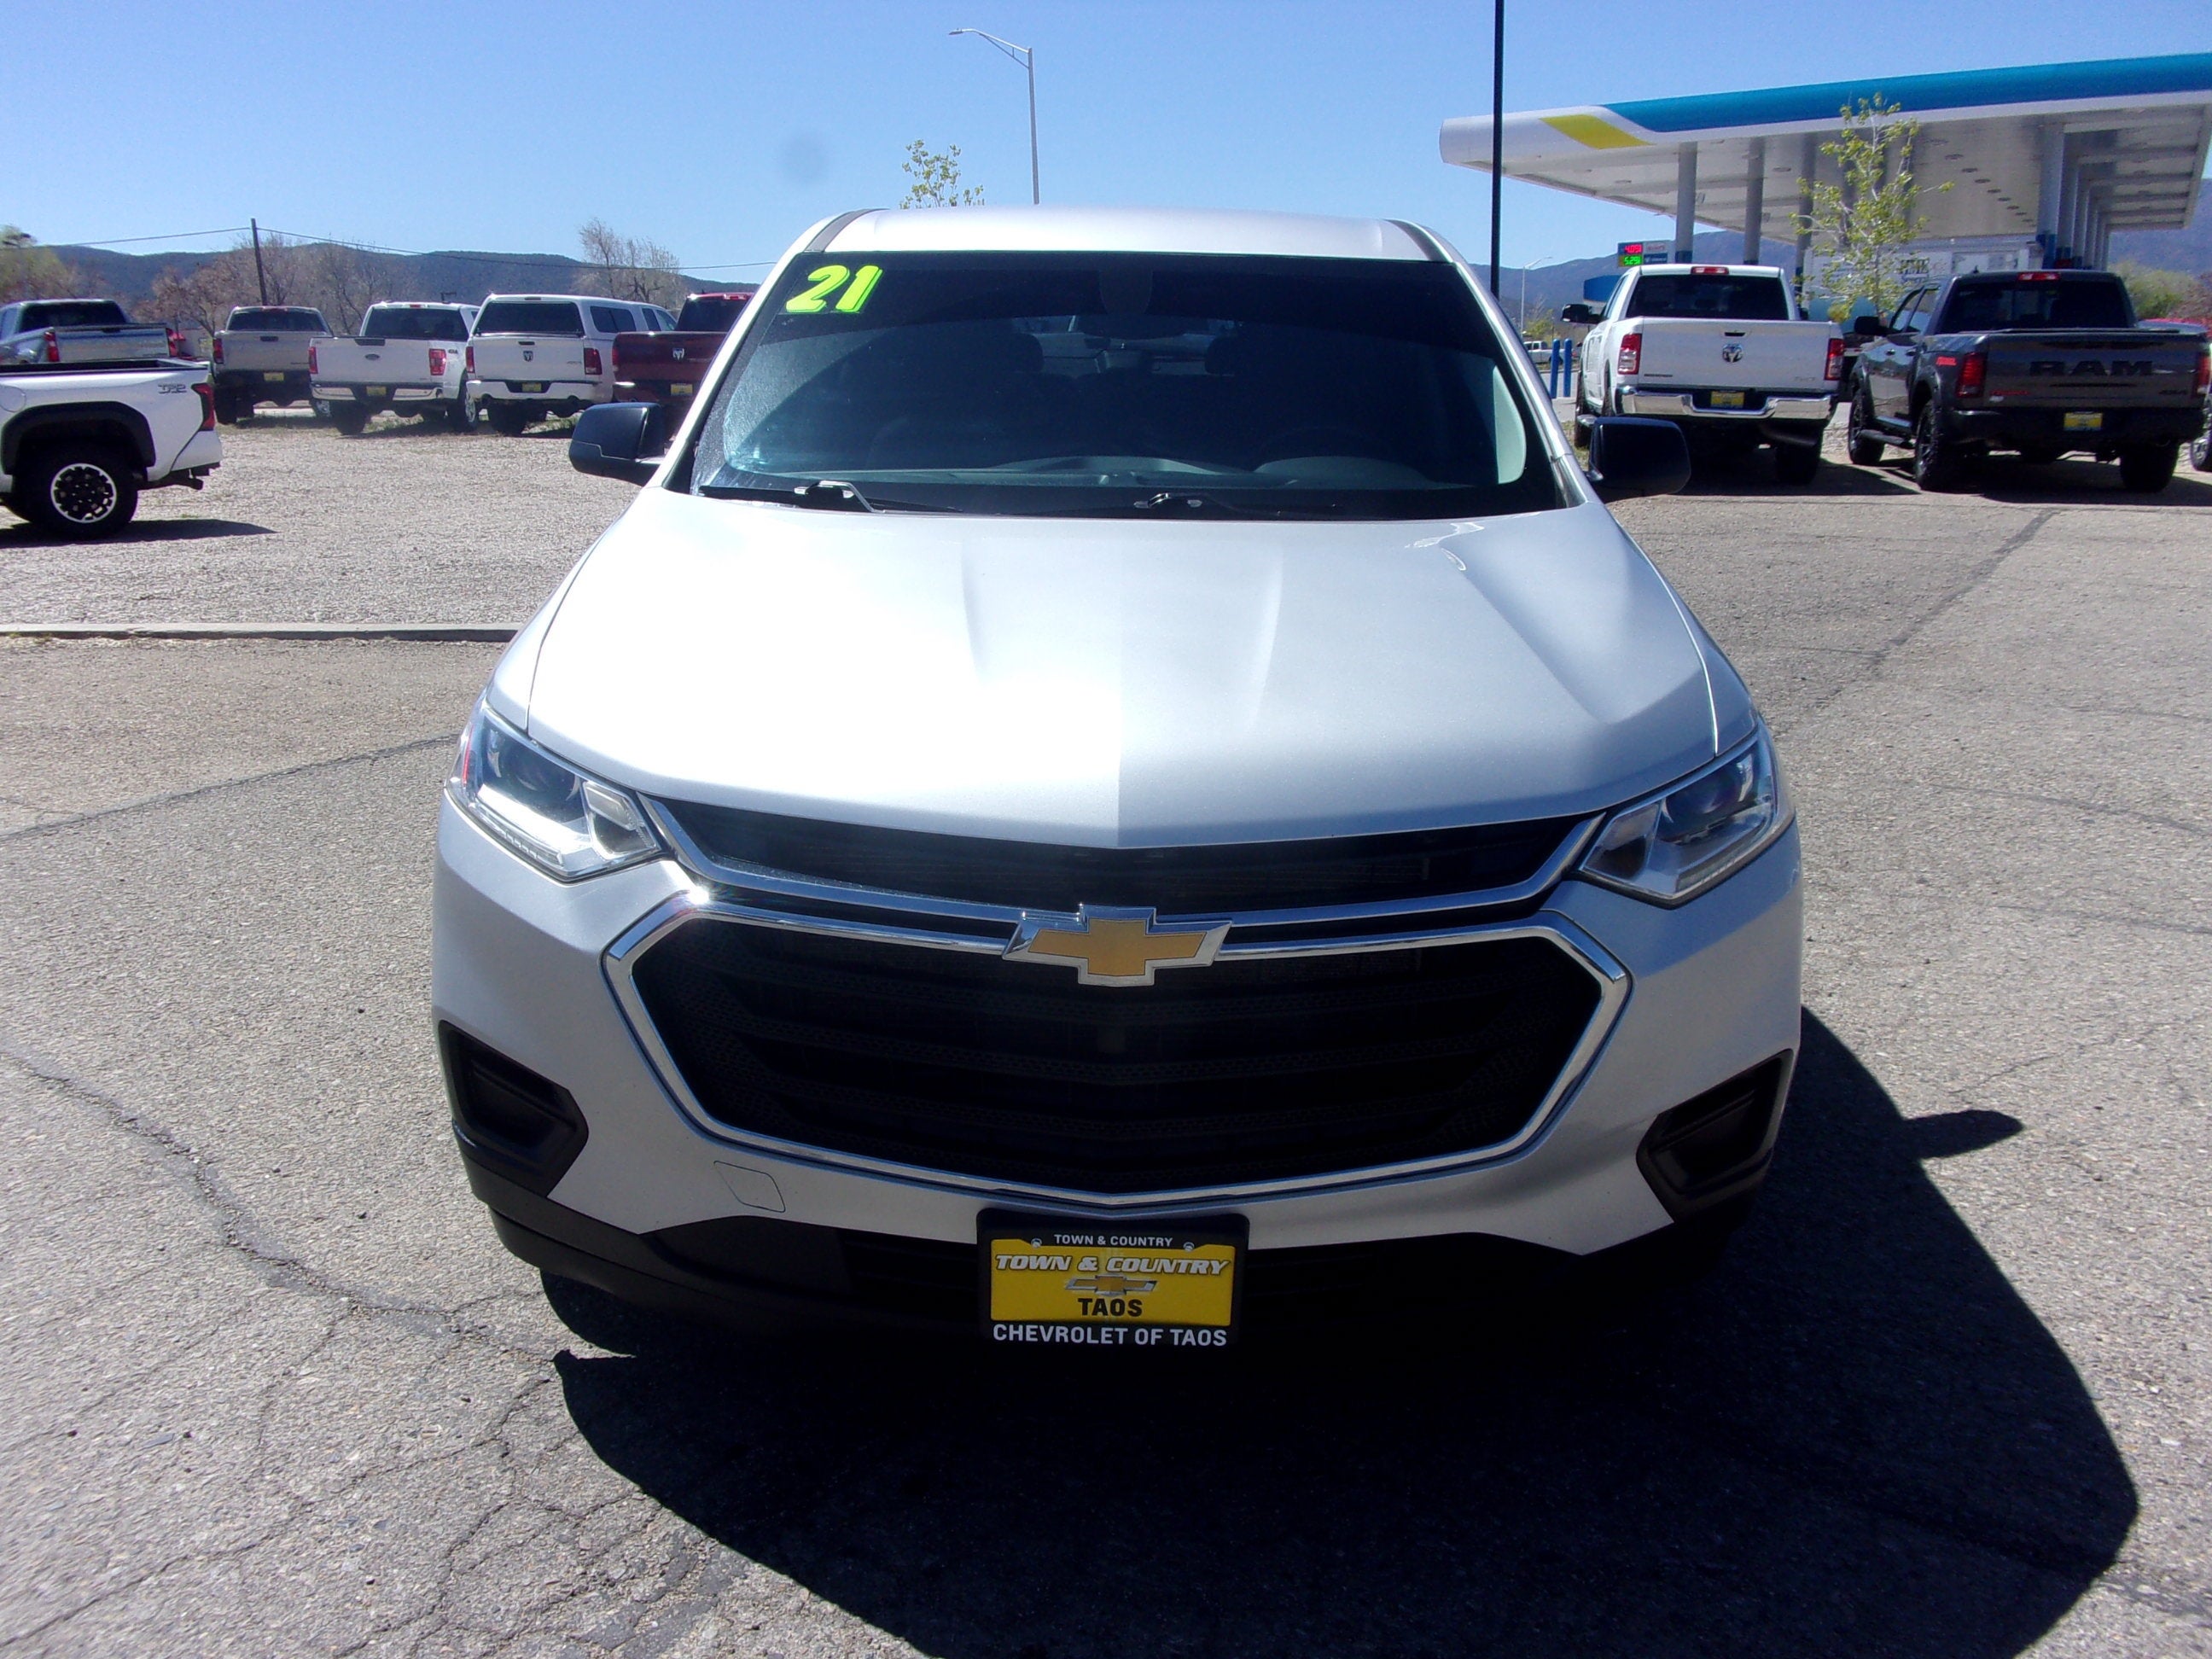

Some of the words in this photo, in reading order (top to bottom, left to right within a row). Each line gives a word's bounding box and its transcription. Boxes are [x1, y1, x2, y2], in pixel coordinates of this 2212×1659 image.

[786, 265, 882, 312] 21
[2030, 361, 2152, 375] RAM
[1054, 1234, 1093, 1245] TOWN
[1097, 1235, 1106, 1245] &
[1110, 1236, 1173, 1247] COUNTRY
[996, 1254, 1072, 1271] TOWN
[1077, 1256, 1099, 1272] &
[1106, 1257, 1229, 1275] COUNTRY
[1078, 1298, 1143, 1317] TAOS
[992, 1324, 1128, 1344] CHEVROLET
[1134, 1328, 1164, 1345] OF
[1169, 1329, 1227, 1347] TAOS
